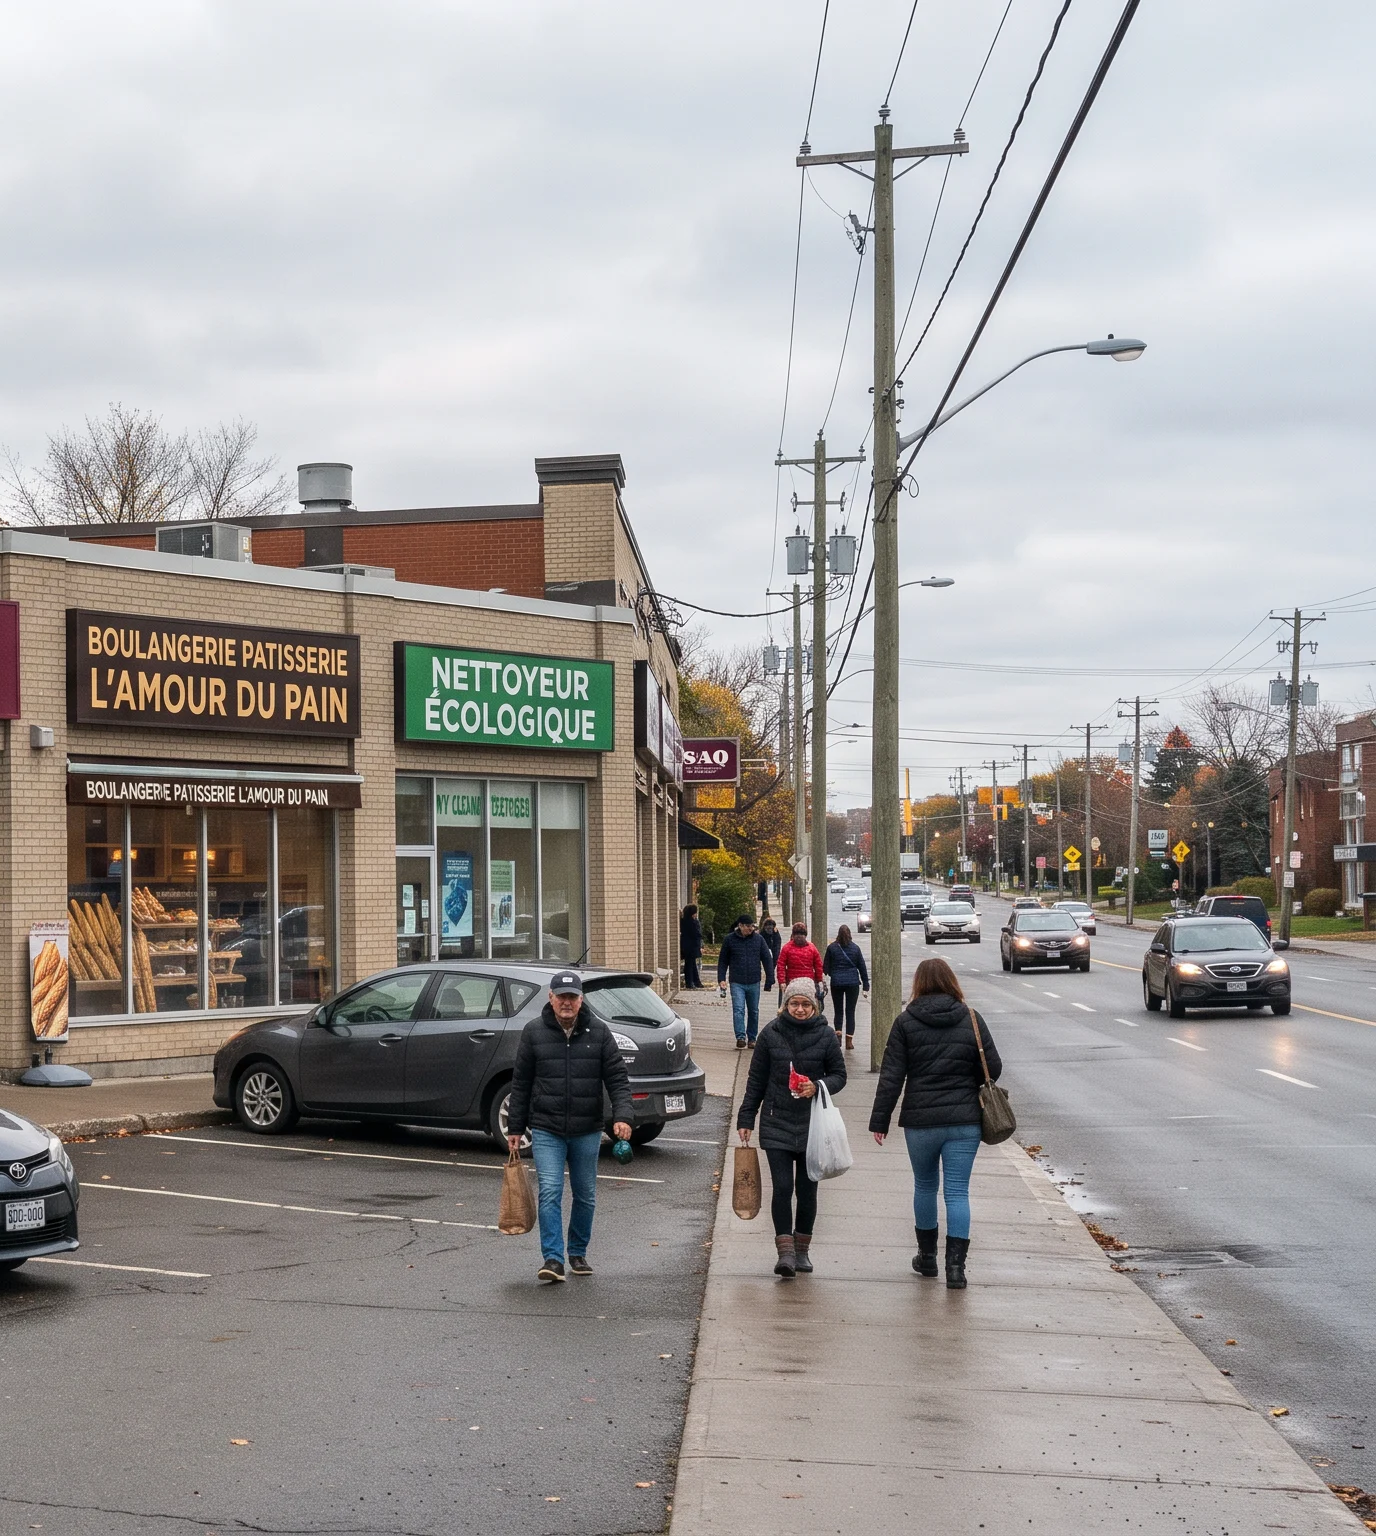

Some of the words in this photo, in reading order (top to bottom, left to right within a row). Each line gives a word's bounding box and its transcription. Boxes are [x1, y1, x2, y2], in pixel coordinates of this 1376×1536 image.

[88, 625, 237, 667] BOULANGERIE
[242, 640, 348, 677] PATISSERIE
[91, 667, 228, 717] L'AMOUR
[237, 679, 275, 720] DU
[285, 683, 347, 724] PAIN
[432, 656, 589, 701] NETTOYEUR
[425, 687, 595, 744] ÉCOLOGIQUE
[683, 749, 729, 768] SAQ
[86, 780, 172, 801] BOULANGERIE
[174, 783, 235, 803] PATISSERIE
[238, 786, 284, 804] L'AMOUR
[288, 788, 302, 805] DU
[305, 789, 329, 806] PAIN
